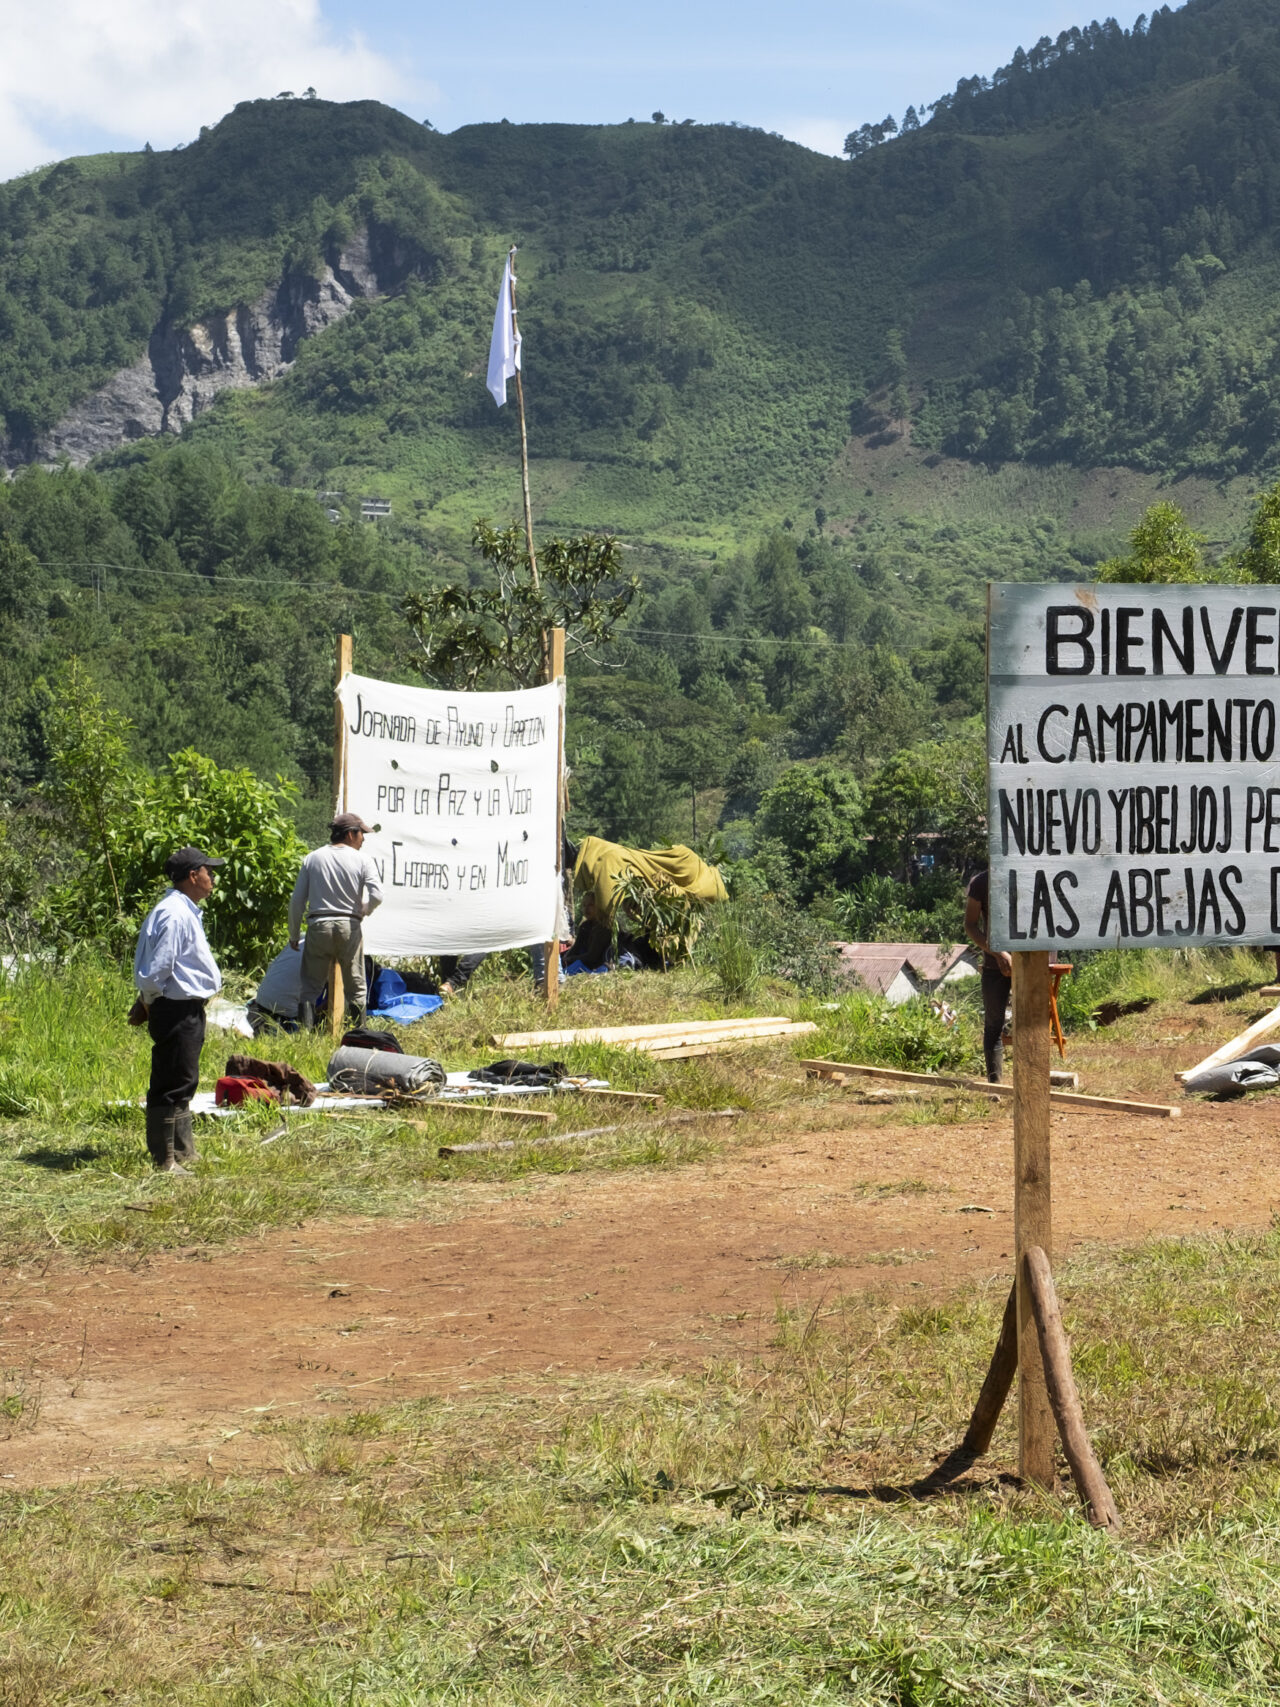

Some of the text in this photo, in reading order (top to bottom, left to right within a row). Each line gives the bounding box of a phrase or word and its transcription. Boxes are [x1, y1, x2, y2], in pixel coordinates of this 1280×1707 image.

[350, 694, 416, 743] JORNADA
[425, 718, 442, 745] DE
[446, 705, 484, 747] AYUNO
[490, 723, 498, 747] Y
[1000, 724, 1029, 763] AL
[1037, 699, 1276, 763] CAMPAMENTO
[377, 773, 532, 816] POR LA PAZ Y LA VIDA
[998, 787, 1102, 856] NUEVO
[1107, 785, 1232, 855] YIBELJOJ
[392, 841, 449, 890] CHIAPAS
[457, 864, 466, 891] Y
[470, 864, 487, 891] EN
[496, 839, 529, 888] MUNDO
[1008, 868, 1081, 940] LAS
[1098, 864, 1246, 937] ABEJAS
